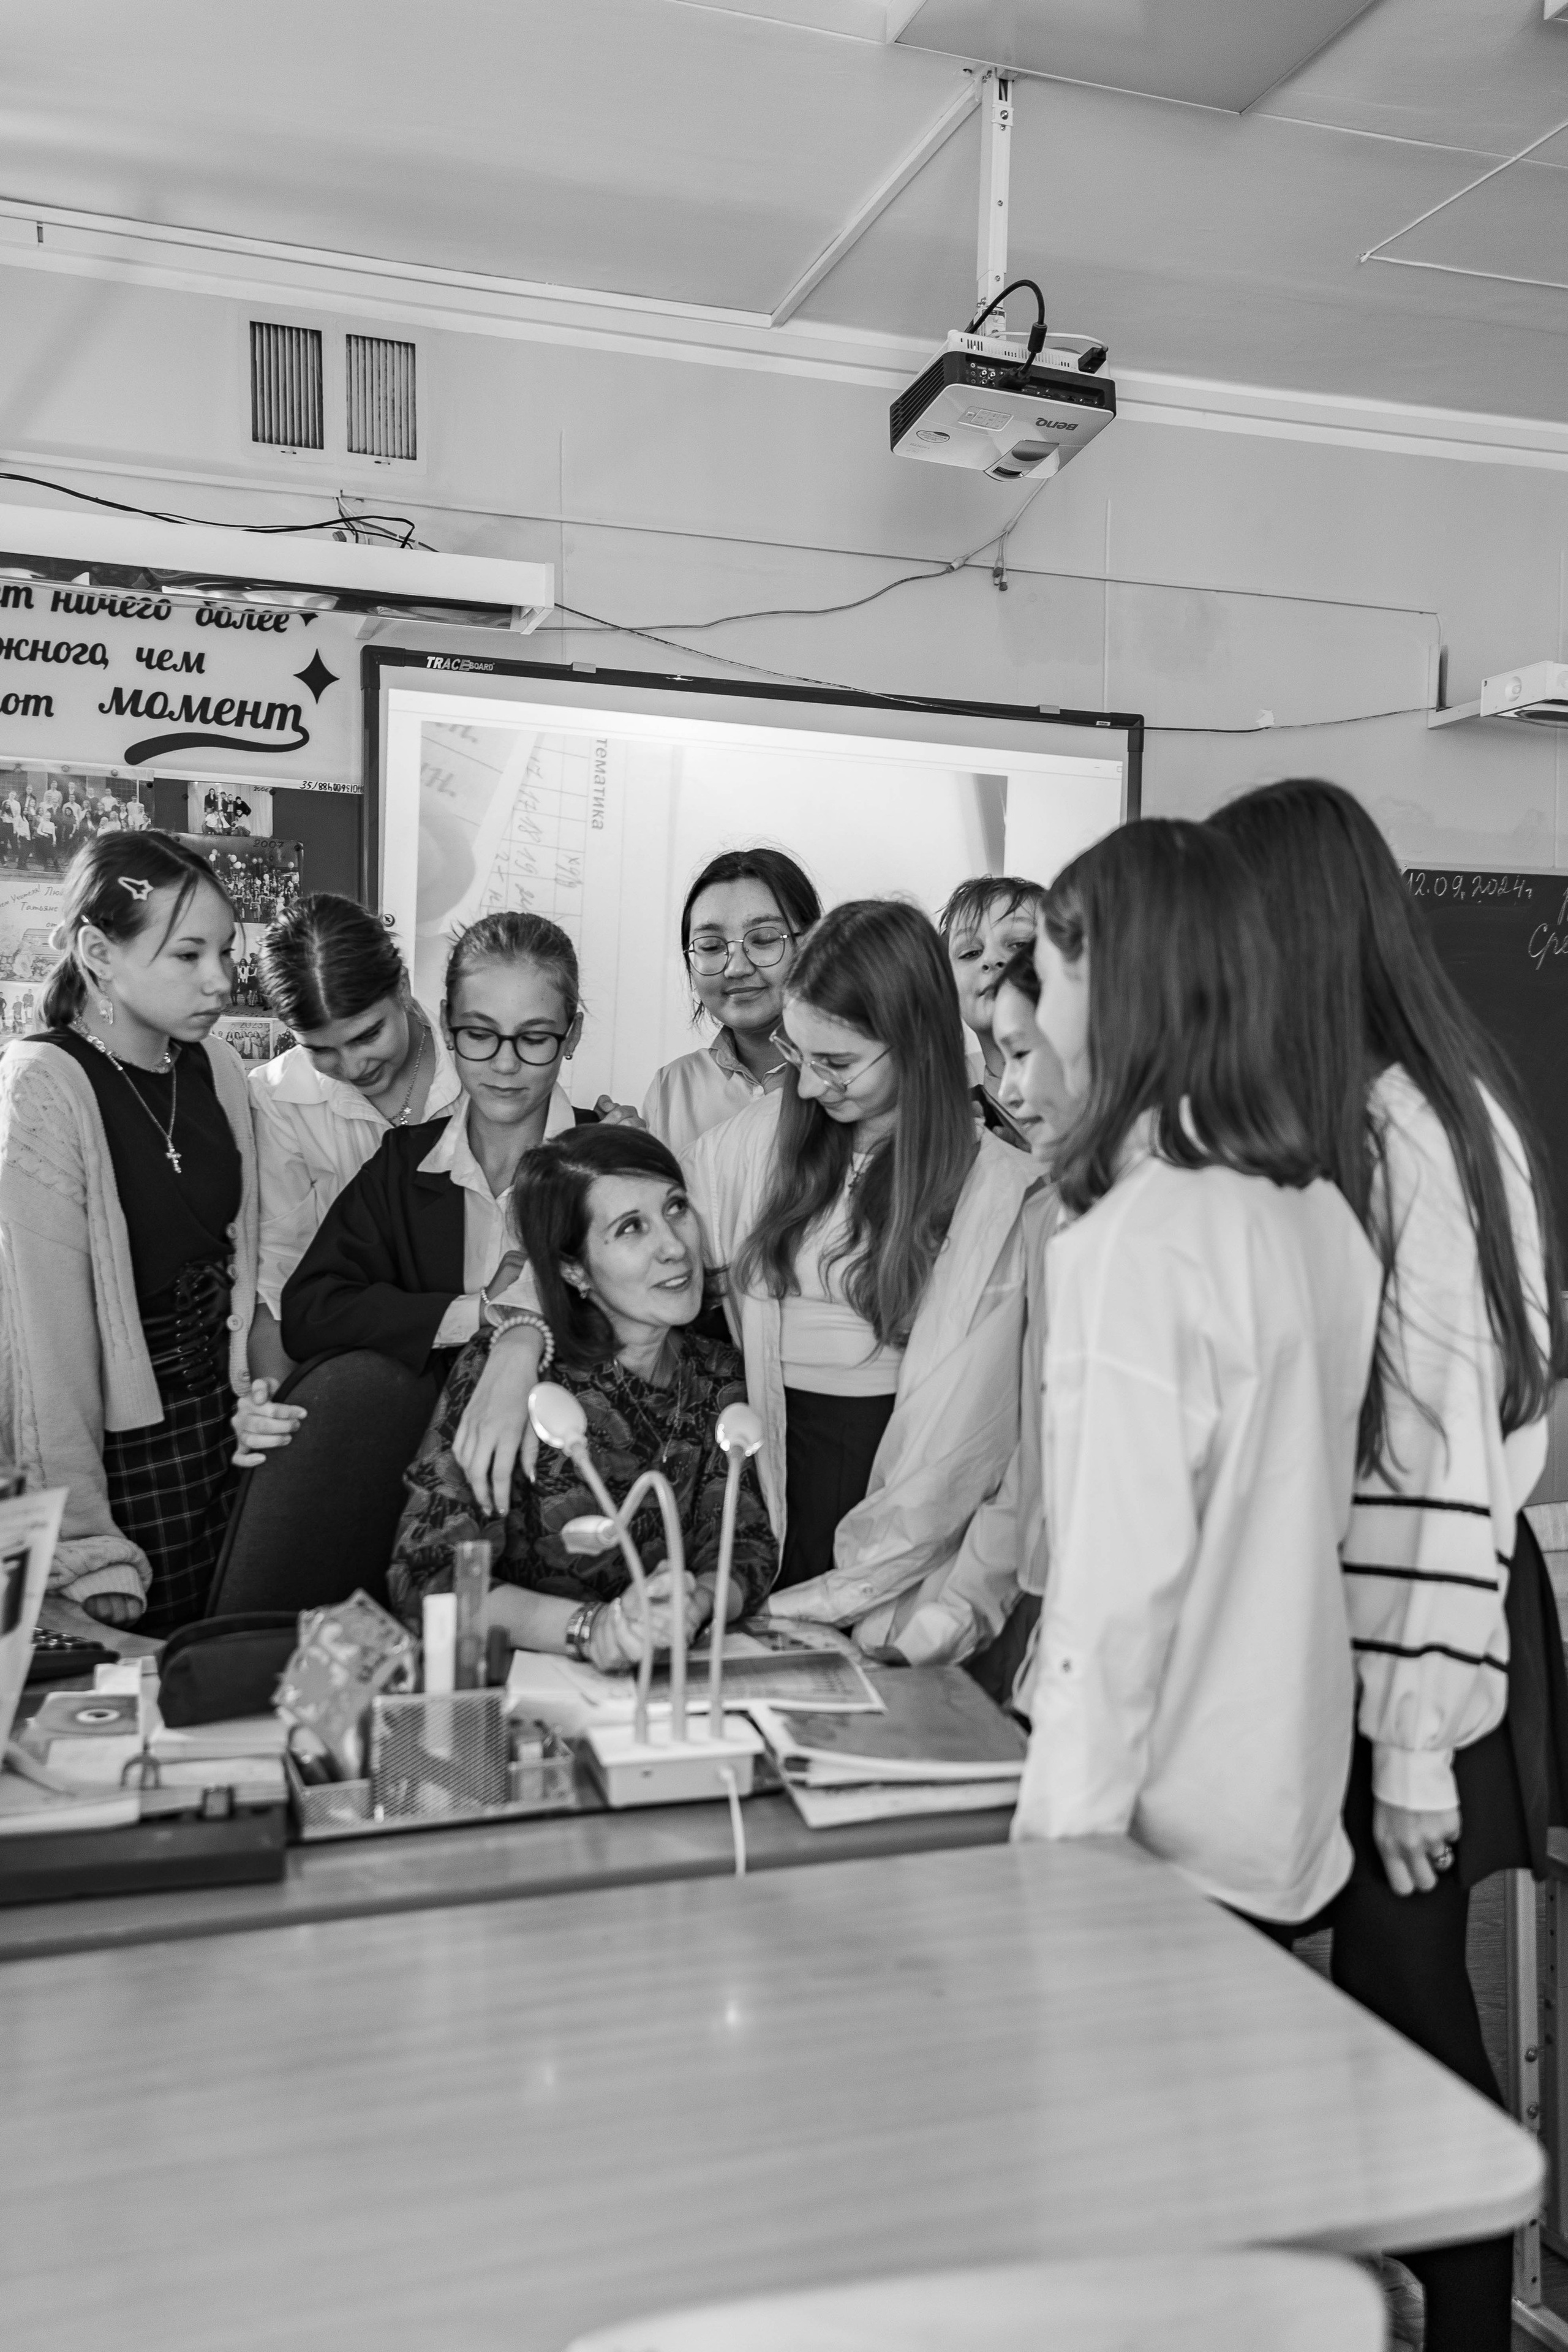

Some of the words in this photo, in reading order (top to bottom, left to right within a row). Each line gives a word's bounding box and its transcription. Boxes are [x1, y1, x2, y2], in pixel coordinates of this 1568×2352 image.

[1035, 417, 1079, 431] BenQ
[0, 585, 34, 609] т
[50, 590, 172, 620] ничего
[135, 647, 205, 674] чем
[98, 687, 303, 732] момент
[591, 738, 608, 831] тематика
[253, 839, 285, 848] 2007
